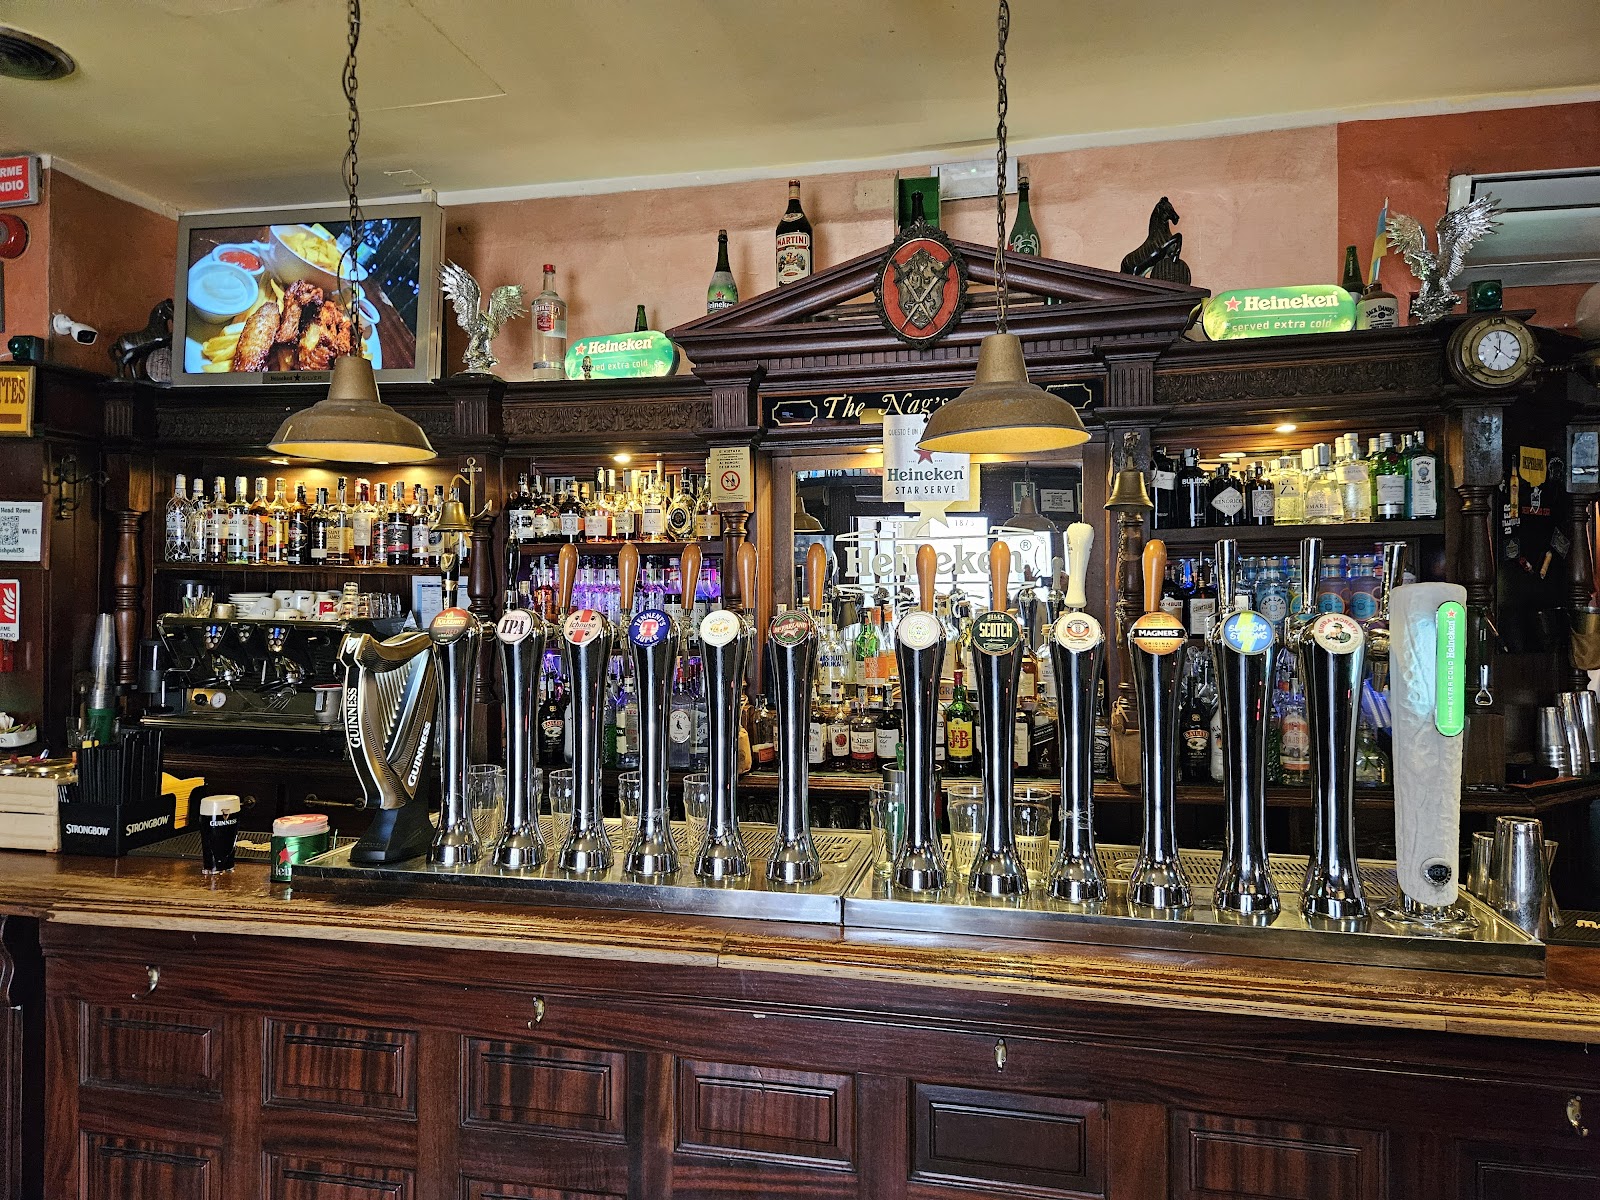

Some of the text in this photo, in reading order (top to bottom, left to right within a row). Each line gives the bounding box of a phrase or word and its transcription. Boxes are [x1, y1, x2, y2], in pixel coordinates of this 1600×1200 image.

[777, 236, 807, 247] MARTINI
[1243, 293, 1339, 312] Heineken
[1232, 318, 1332, 333] served extra cold
[587, 337, 653, 355] Heineken
[608, 360, 630, 371] extra
[632, 359, 648, 369] cold
[823, 393, 866, 420] The
[887, 467, 964, 482] Heineken
[895, 485, 956, 495] STAR SERVE
[500, 619, 525, 635] IPA
[633, 612, 667, 628] TENNENT'S
[1318, 616, 1359, 635] BIRRA MORETTI
[635, 633, 659, 643] SUPER
[979, 622, 1013, 638] SCOTCH
[1138, 629, 1179, 637] MAGNERS
[1445, 619, 1456, 659] Heineken
[1447, 661, 1455, 679] COLD
[1447, 681, 1455, 705] EXTRA
[346, 687, 361, 748] GUINNESS
[407, 720, 432, 788] GUINNESS
[66, 823, 110, 836] STRONGBOW
[125, 815, 170, 836] STRONGBOW
[209, 819, 238, 827] GUINNESS
